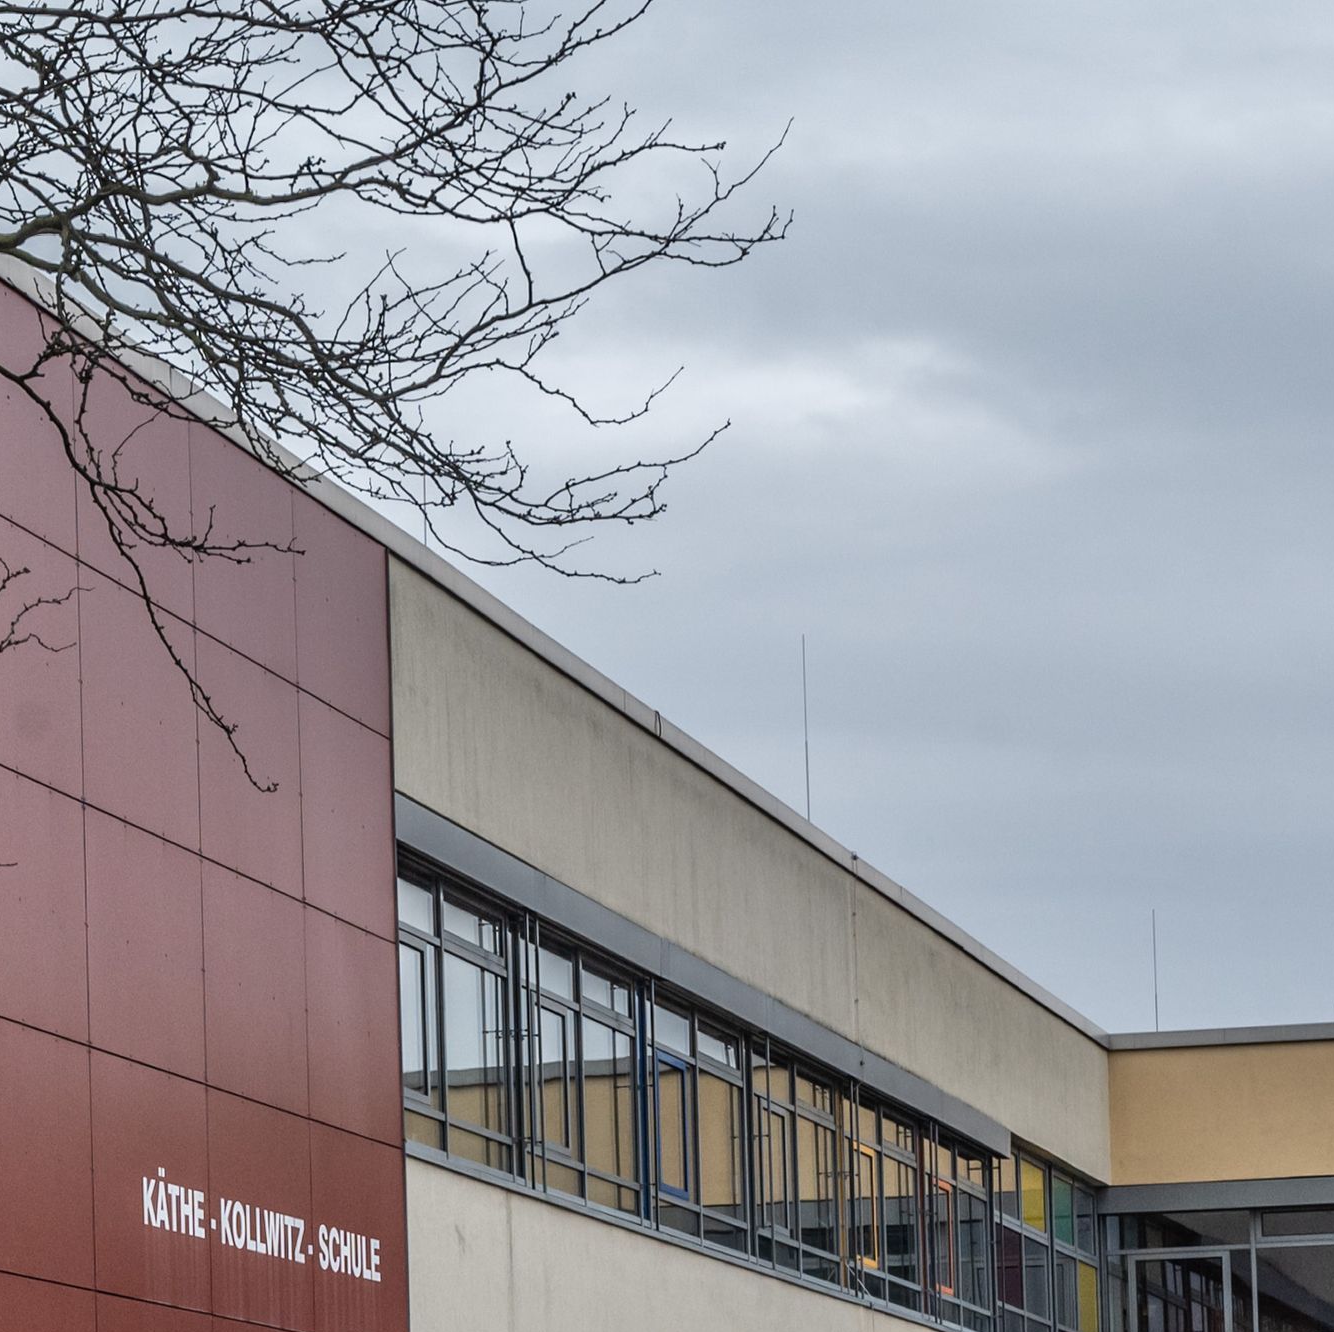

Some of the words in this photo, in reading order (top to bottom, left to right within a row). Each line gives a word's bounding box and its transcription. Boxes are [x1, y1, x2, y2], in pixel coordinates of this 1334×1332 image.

[142, 1166, 206, 1239] KÄTHE
[220, 1197, 306, 1264] KOLLWITZ
[318, 1223, 381, 1282] SCHULE
